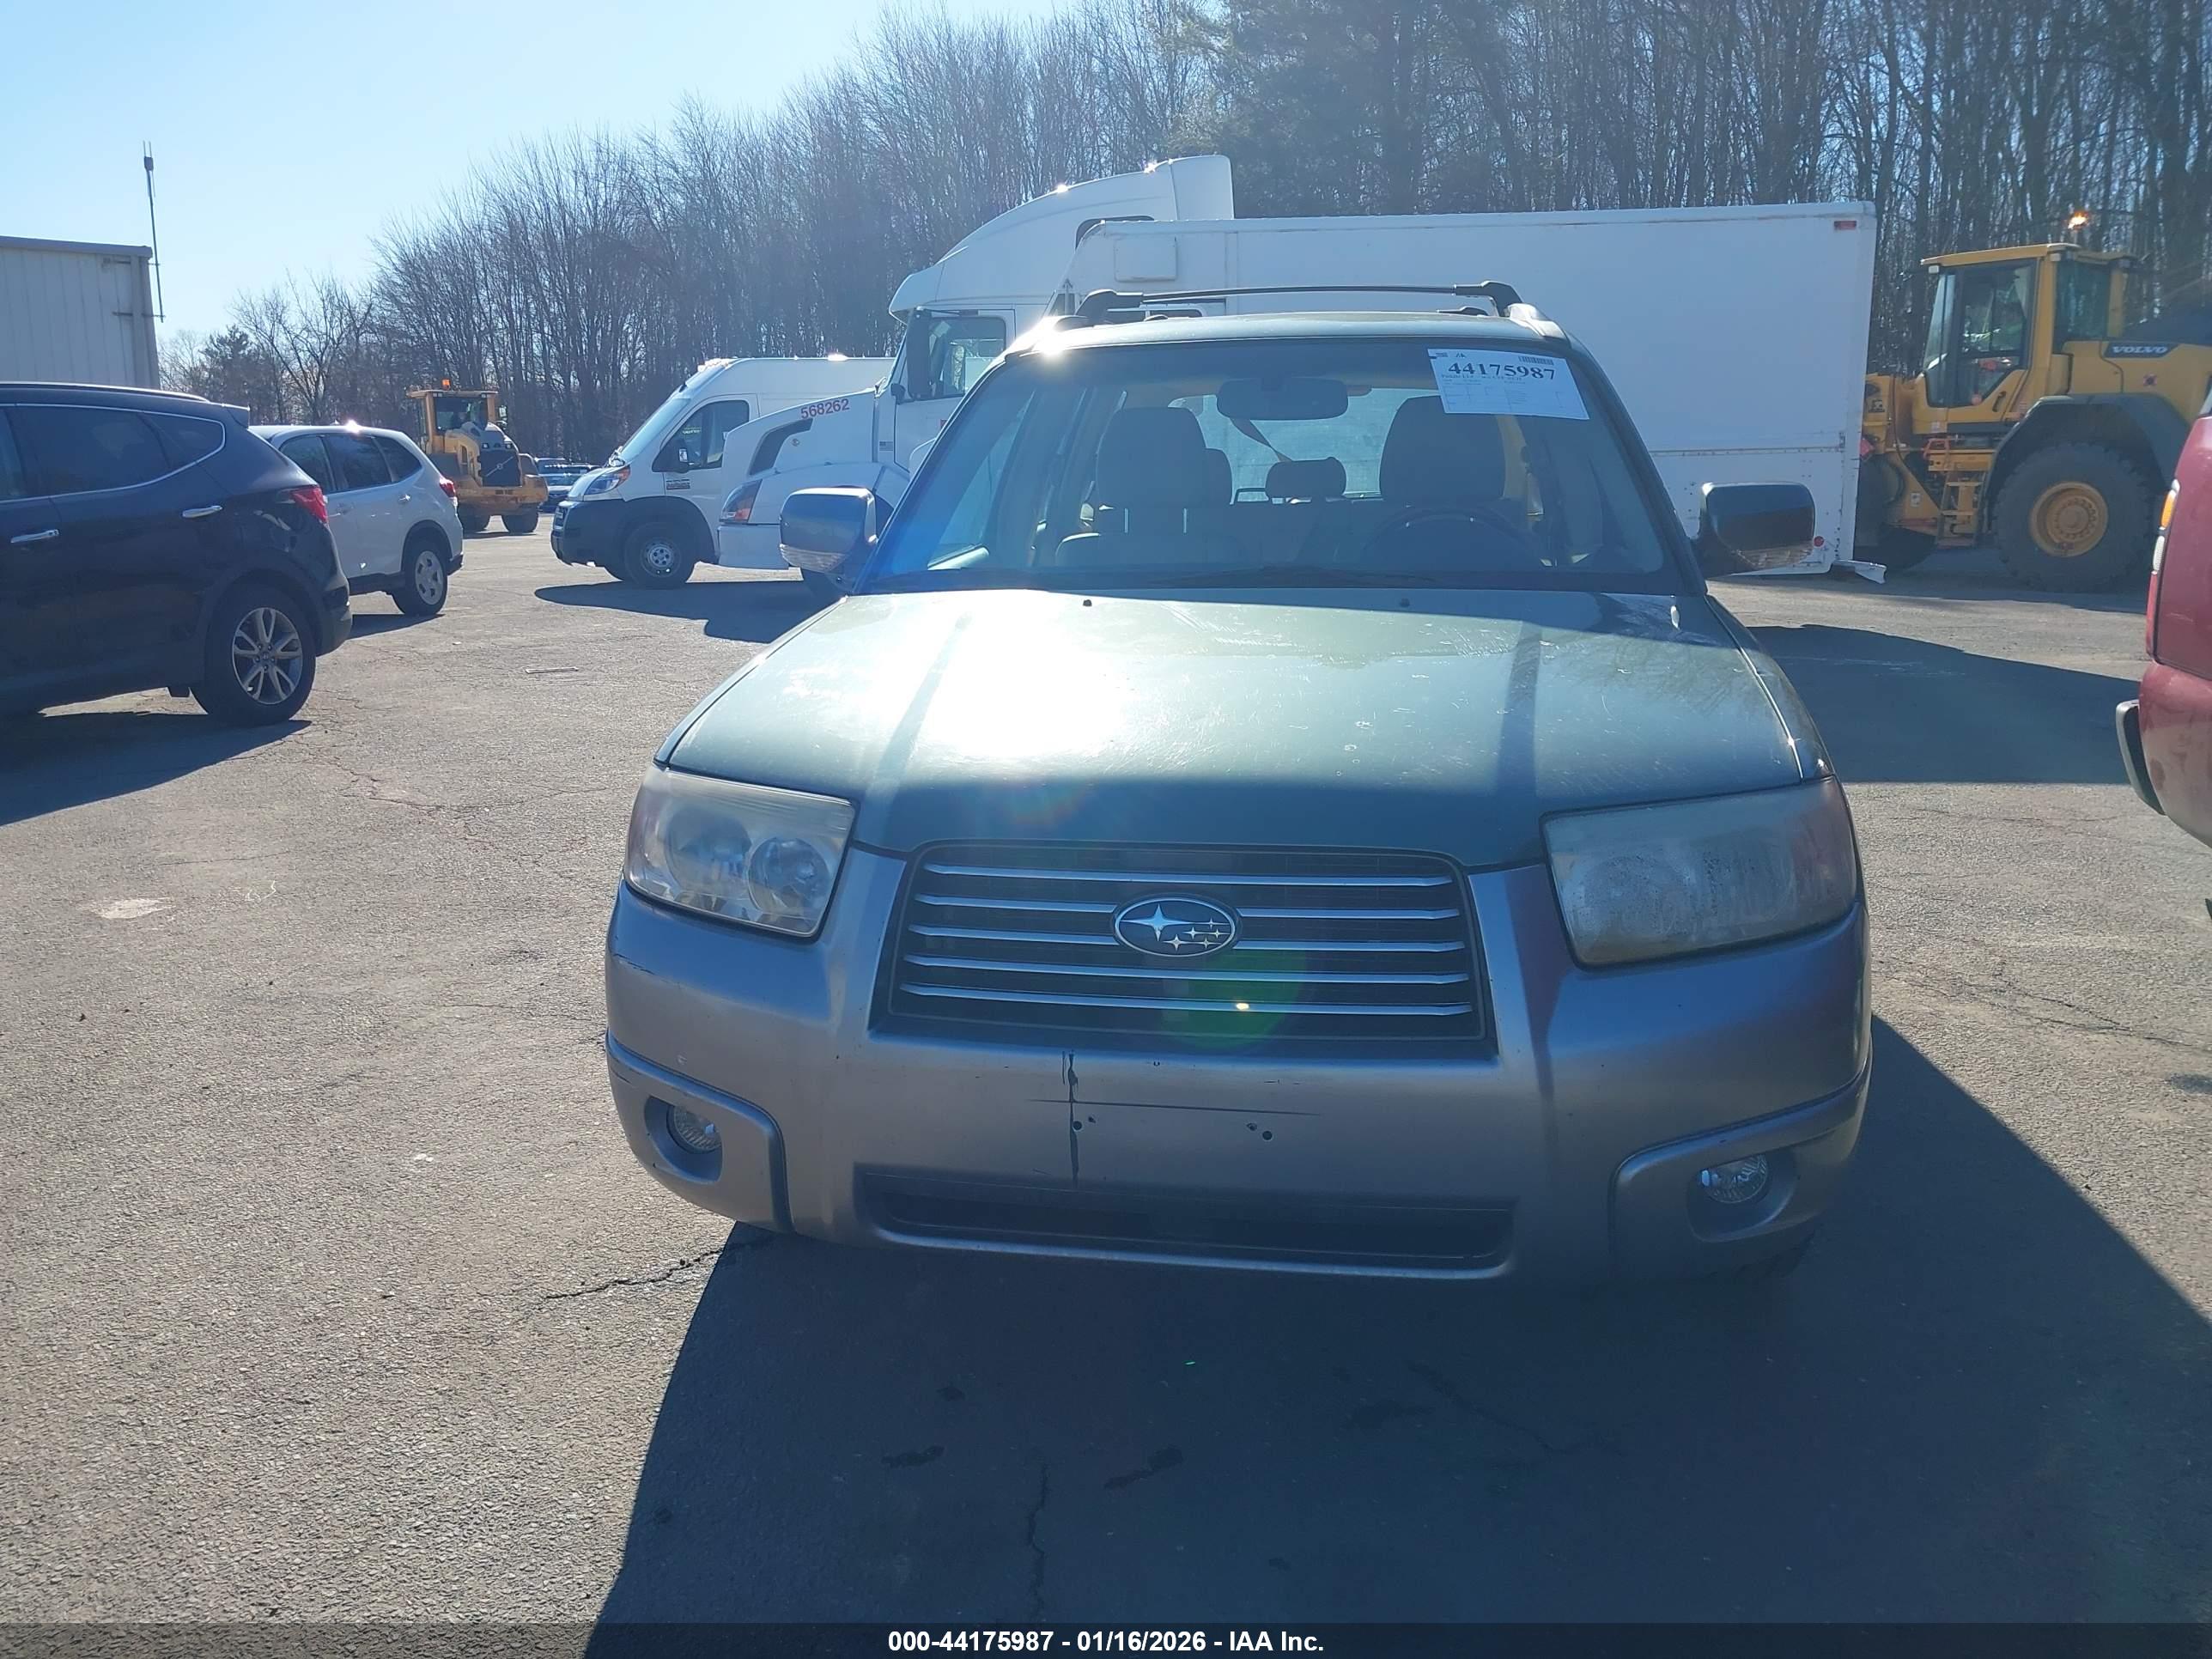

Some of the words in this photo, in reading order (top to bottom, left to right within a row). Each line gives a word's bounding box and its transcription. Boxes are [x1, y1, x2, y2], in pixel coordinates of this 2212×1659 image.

[2112, 345, 2167, 354] VOLVO
[1448, 362, 1555, 380] 44175987
[800, 398, 850, 419] 568262
